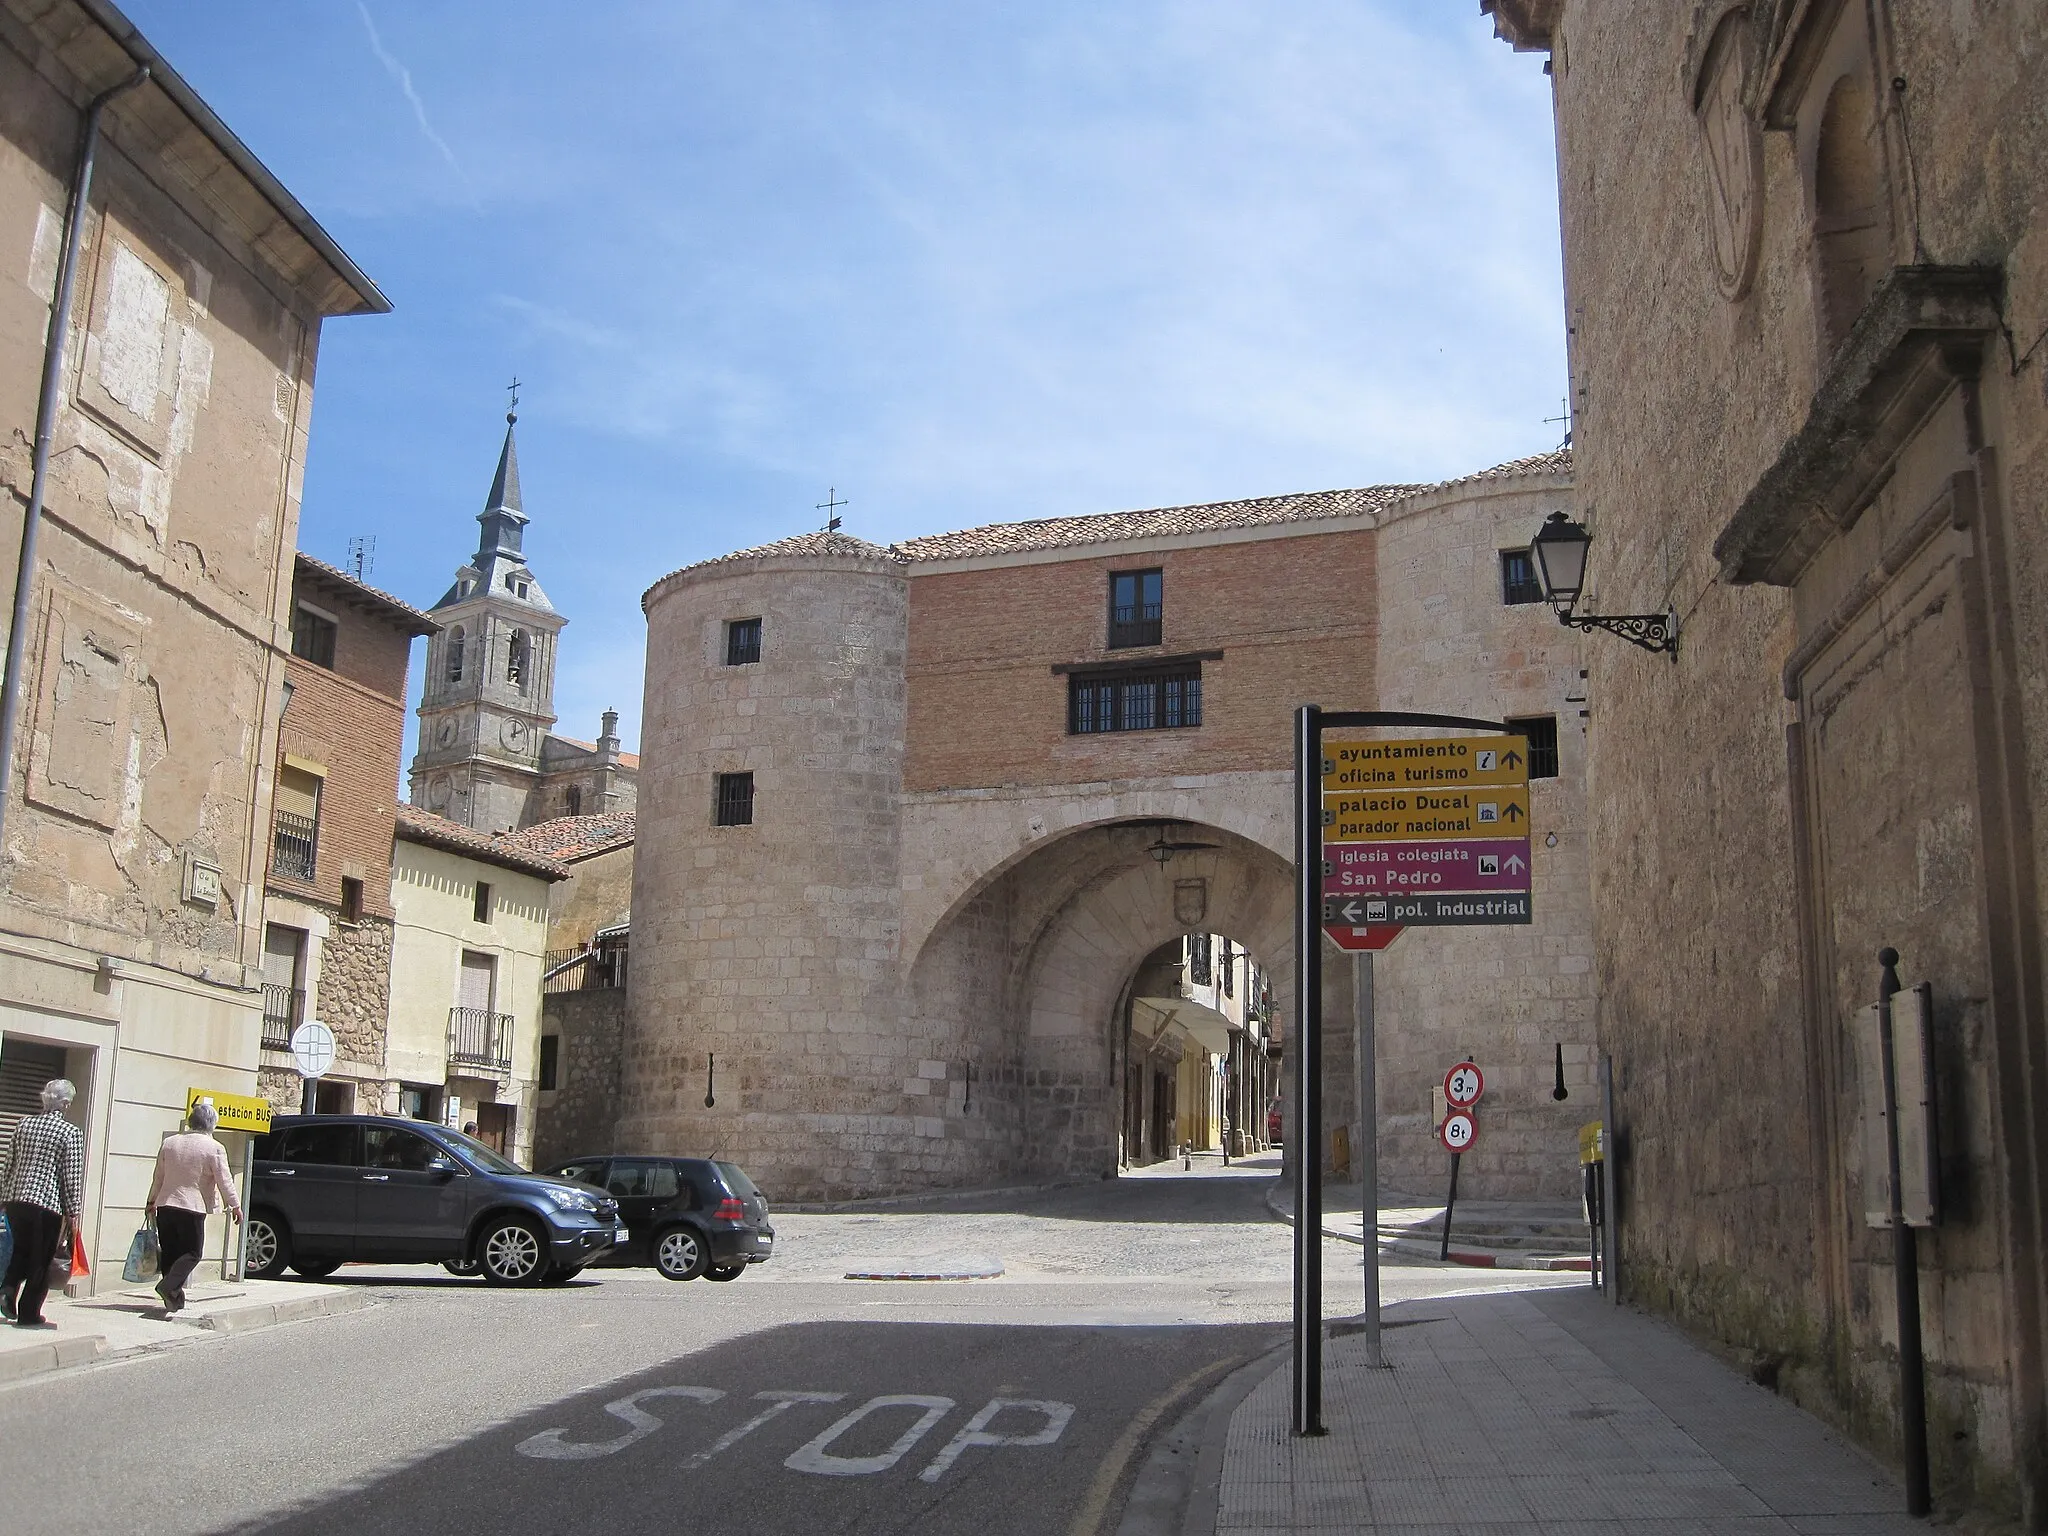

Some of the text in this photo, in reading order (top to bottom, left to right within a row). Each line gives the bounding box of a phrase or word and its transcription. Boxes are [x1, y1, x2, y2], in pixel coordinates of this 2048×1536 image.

[1340, 743, 1468, 763] ayuntamiento
[1340, 767, 1469, 783] oficina turismo
[1340, 795, 1469, 814] palacio Ducal
[1341, 817, 1470, 836] parador nacional
[1341, 848, 1468, 864] iglesia colegiata
[1341, 870, 1441, 885] San Pedro
[1395, 900, 1526, 919] pol. industrial
[257, 1109, 270, 1122] BUS
[514, 1384, 1076, 1482] STOP
